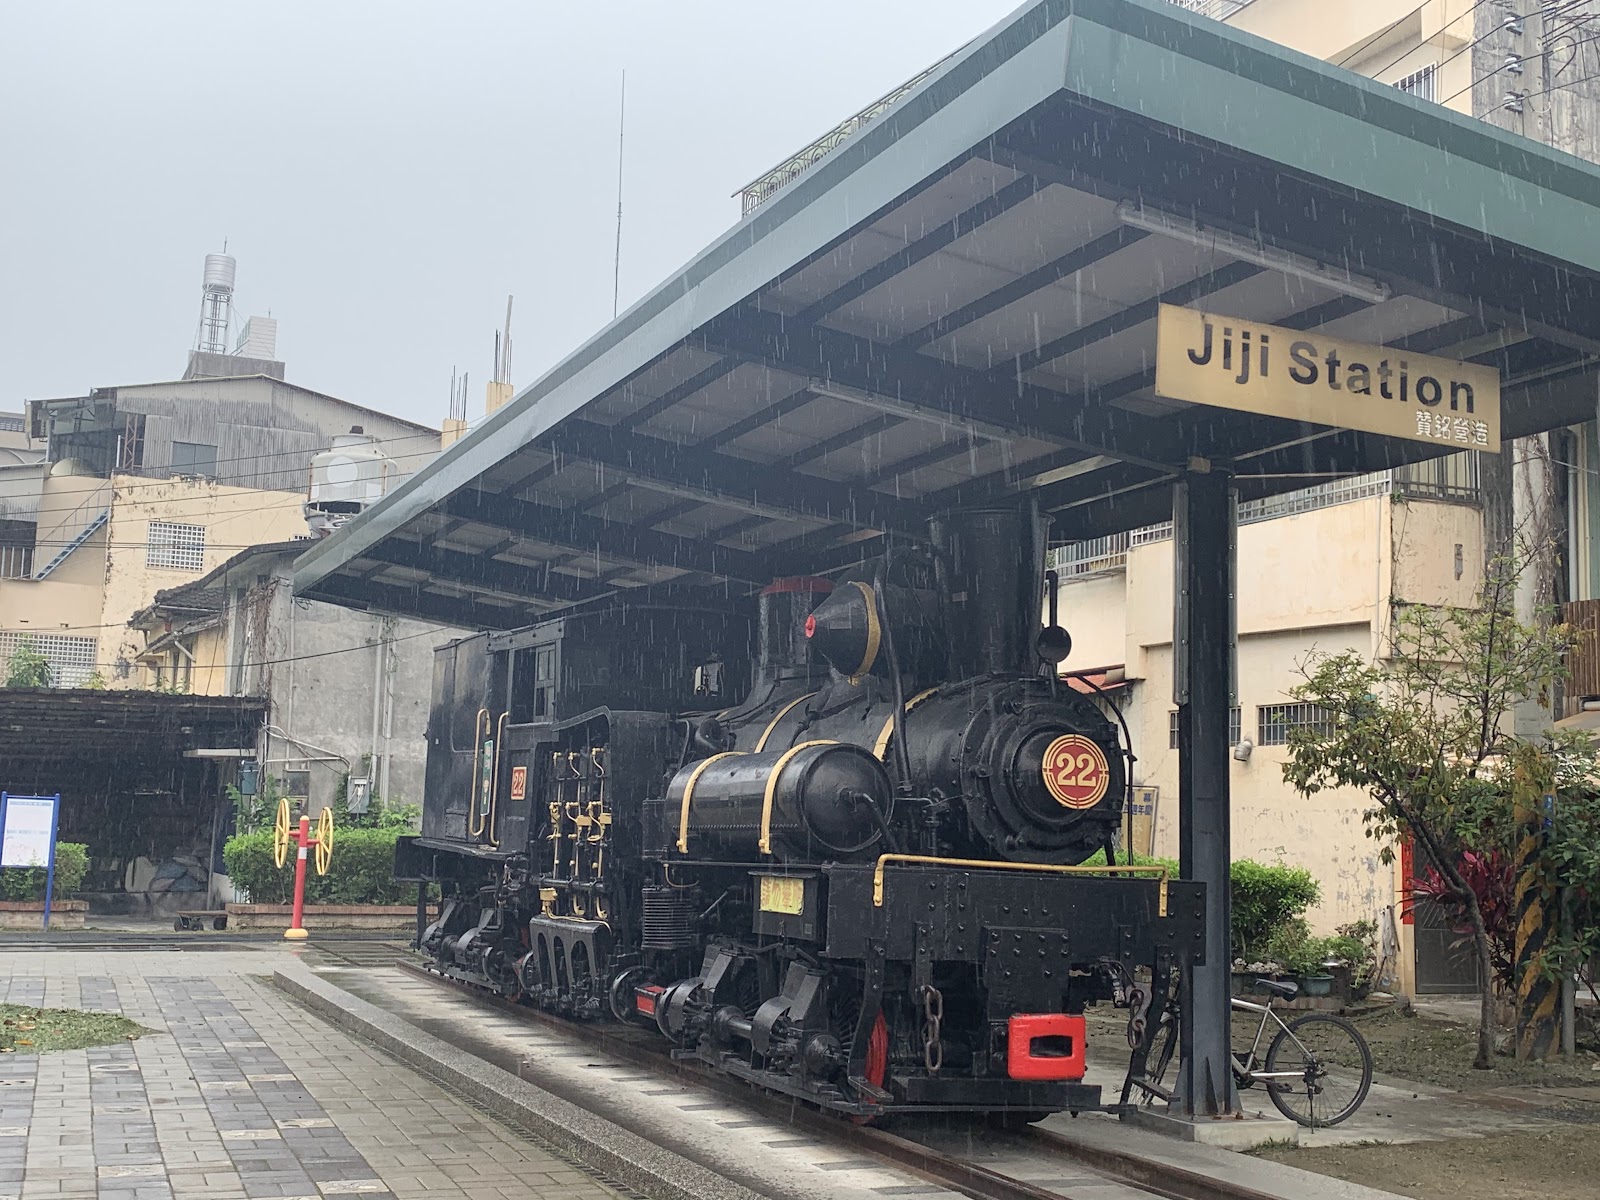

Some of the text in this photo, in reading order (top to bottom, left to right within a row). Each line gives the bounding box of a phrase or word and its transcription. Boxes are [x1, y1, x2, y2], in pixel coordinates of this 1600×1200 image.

[1187, 323, 1474, 414] Jiji Station
[513, 772, 524, 795] 22
[1056, 753, 1097, 787] 22
